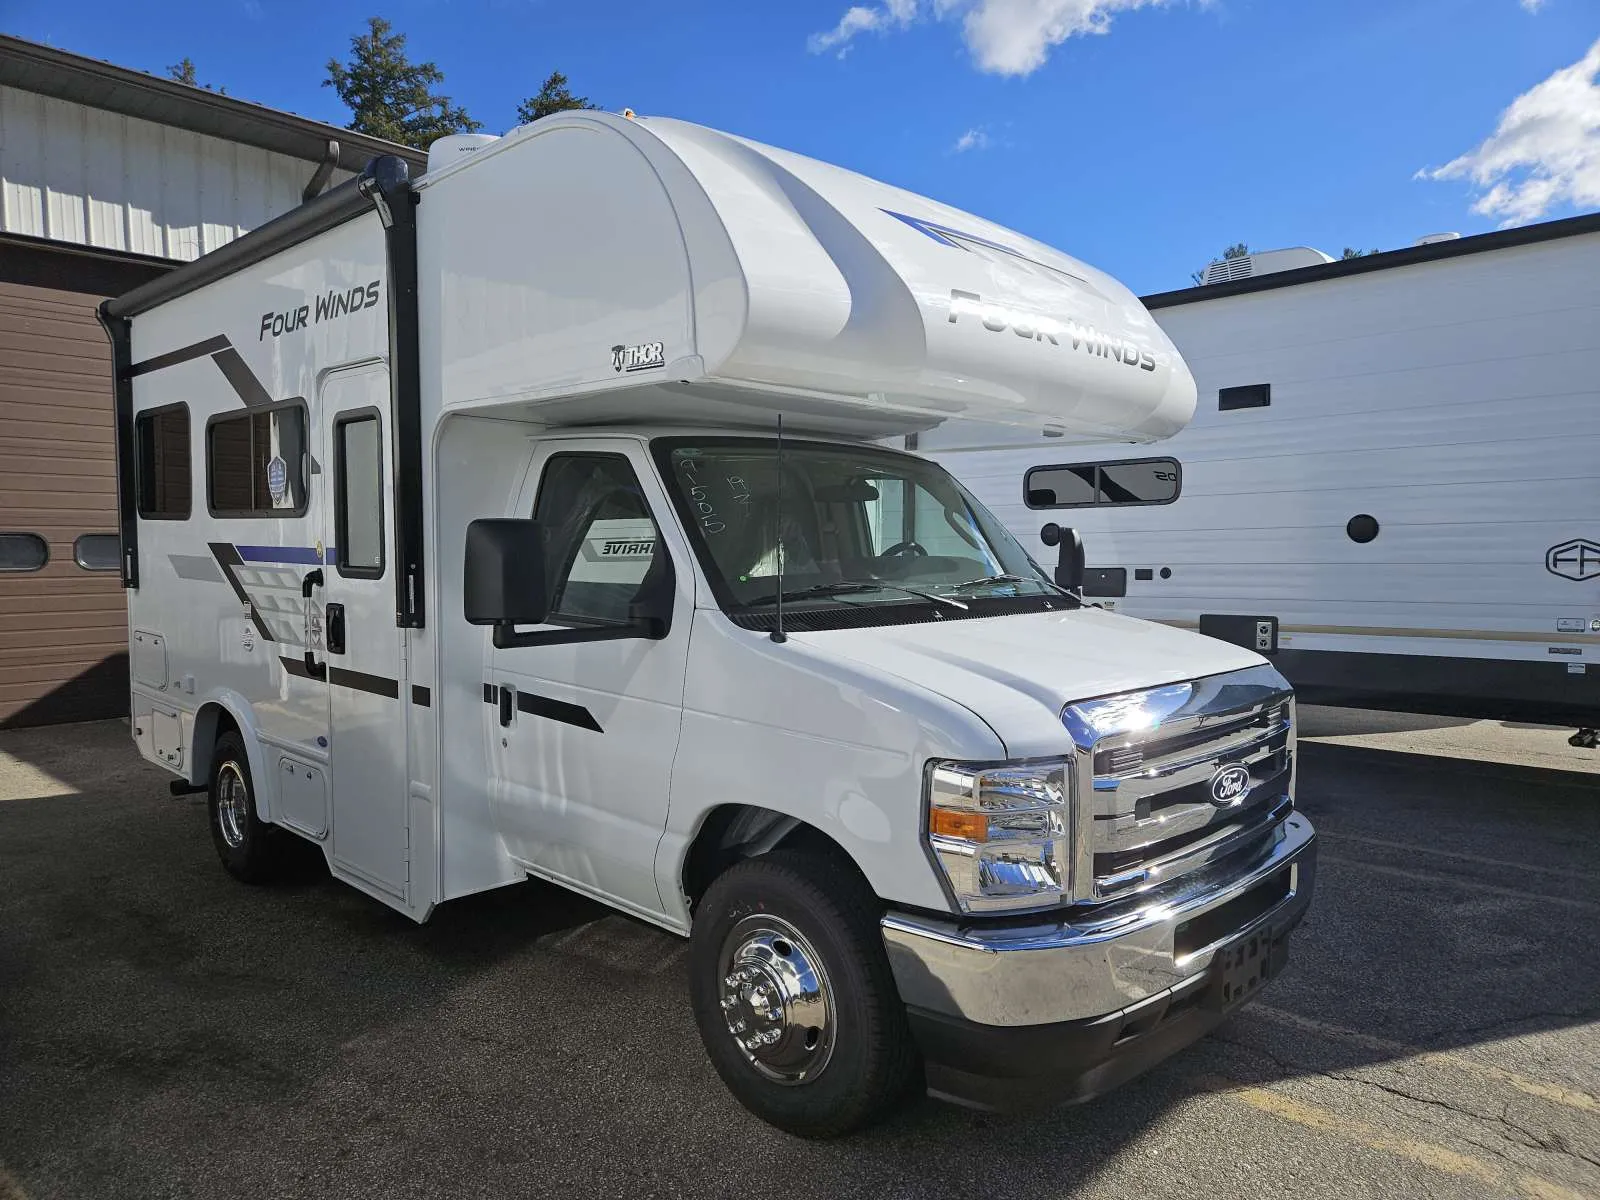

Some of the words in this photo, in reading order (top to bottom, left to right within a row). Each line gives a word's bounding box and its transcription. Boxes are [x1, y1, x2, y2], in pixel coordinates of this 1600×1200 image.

[260, 304, 310, 341] FOUR
[315, 280, 380, 324] WINDS
[626, 342, 664, 366] THOR
[1219, 772, 1243, 798] Ford
